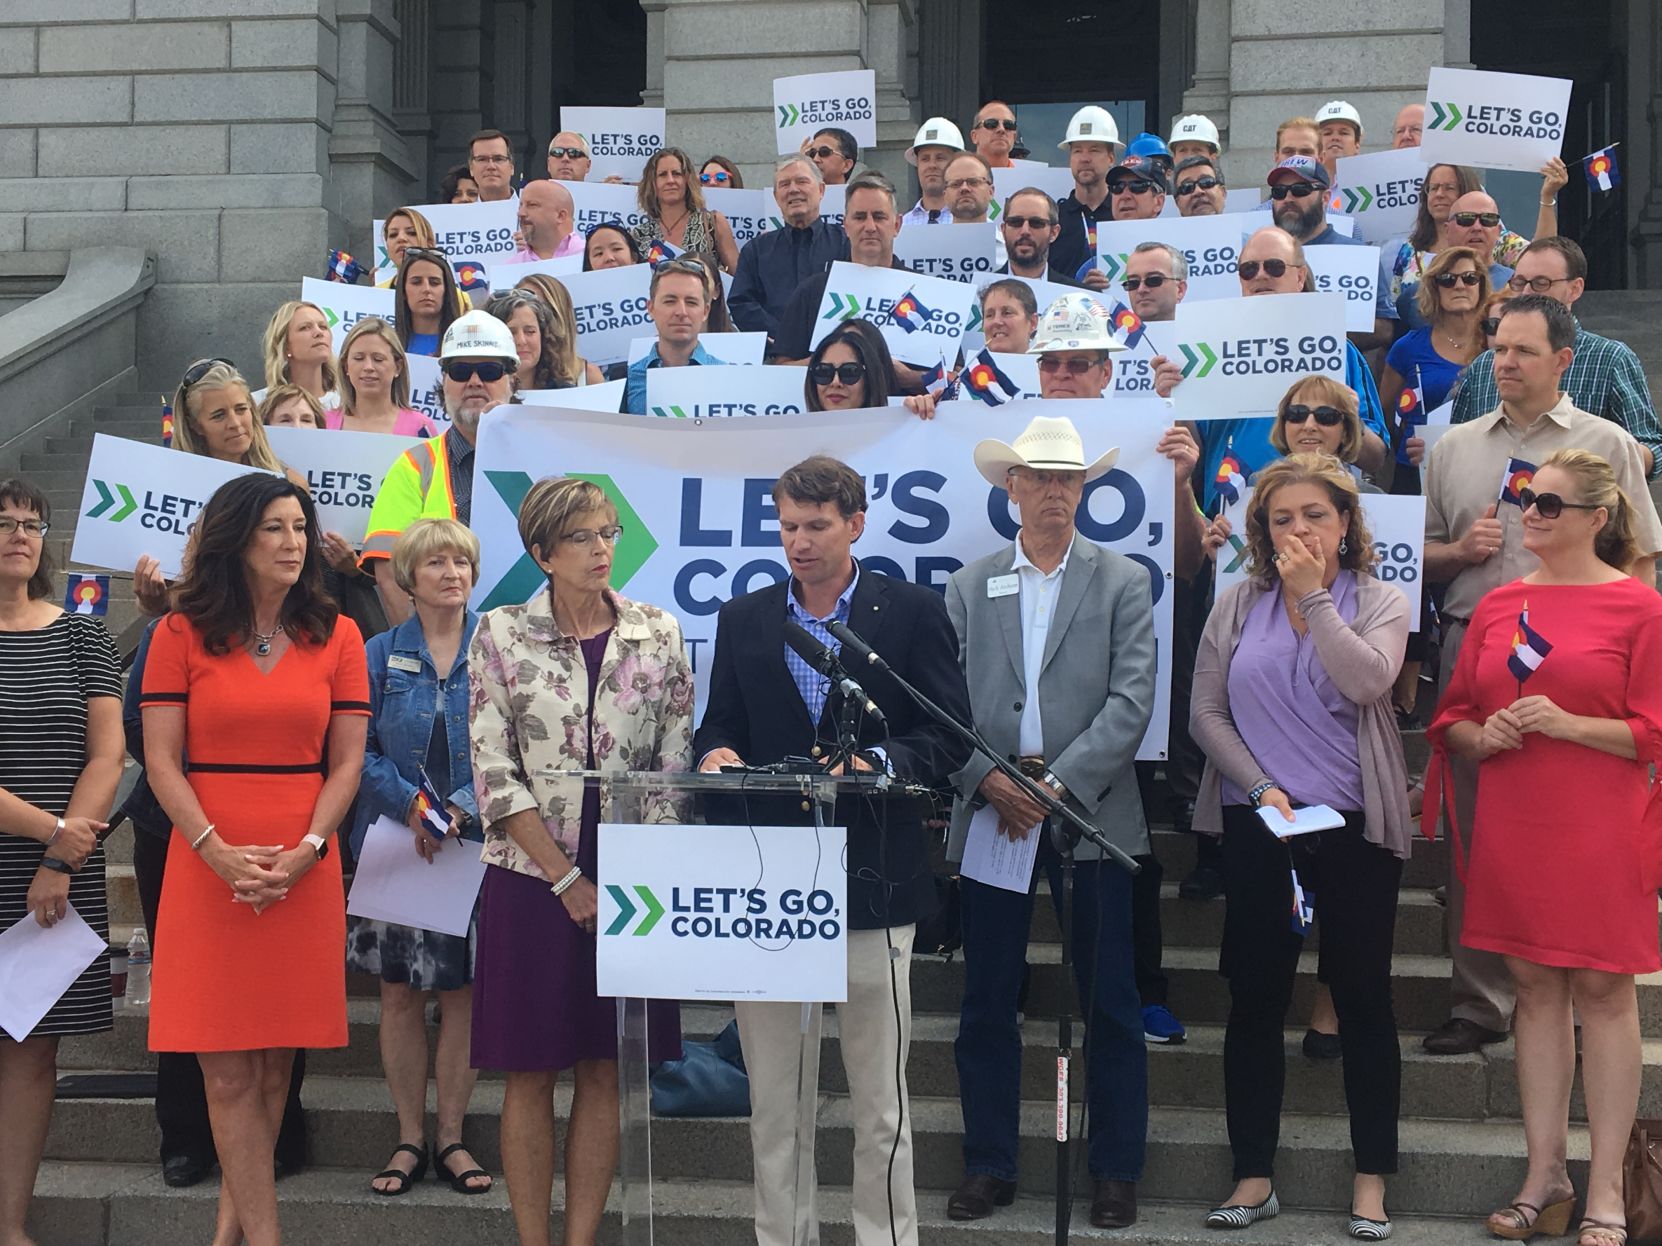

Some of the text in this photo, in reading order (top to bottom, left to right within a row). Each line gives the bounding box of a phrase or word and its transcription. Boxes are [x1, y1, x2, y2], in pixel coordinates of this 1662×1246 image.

[801, 97, 872, 113] LET'S GO,
[801, 110, 872, 124] COLORADO
[1466, 105, 1562, 129] LET'S GO,
[591, 133, 663, 147] LET'S GO,
[1465, 121, 1561, 140] COLORADO
[1376, 178, 1424, 197] LET'S
[1377, 194, 1419, 209] COLO
[578, 209, 621, 223] LET'S
[435, 228, 514, 245] LET'S GO,
[960, 256, 993, 272] GO,
[1203, 246, 1239, 263] GO,
[1189, 262, 1239, 277] RADO
[1338, 275, 1374, 290] GO,
[574, 302, 614, 321] ET'S
[930, 308, 963, 327] GO,
[575, 313, 654, 335] OLORADO
[863, 313, 961, 338] COLADO
[1222, 335, 1342, 358] LET'S GO,
[1118, 359, 1149, 376] T'S
[1221, 356, 1342, 375] COLORADO
[307, 470, 373, 492] LET'S
[144, 490, 203, 518] LET'
[671, 887, 840, 917] LET'S GO,
[671, 916, 841, 940] COLORADO
